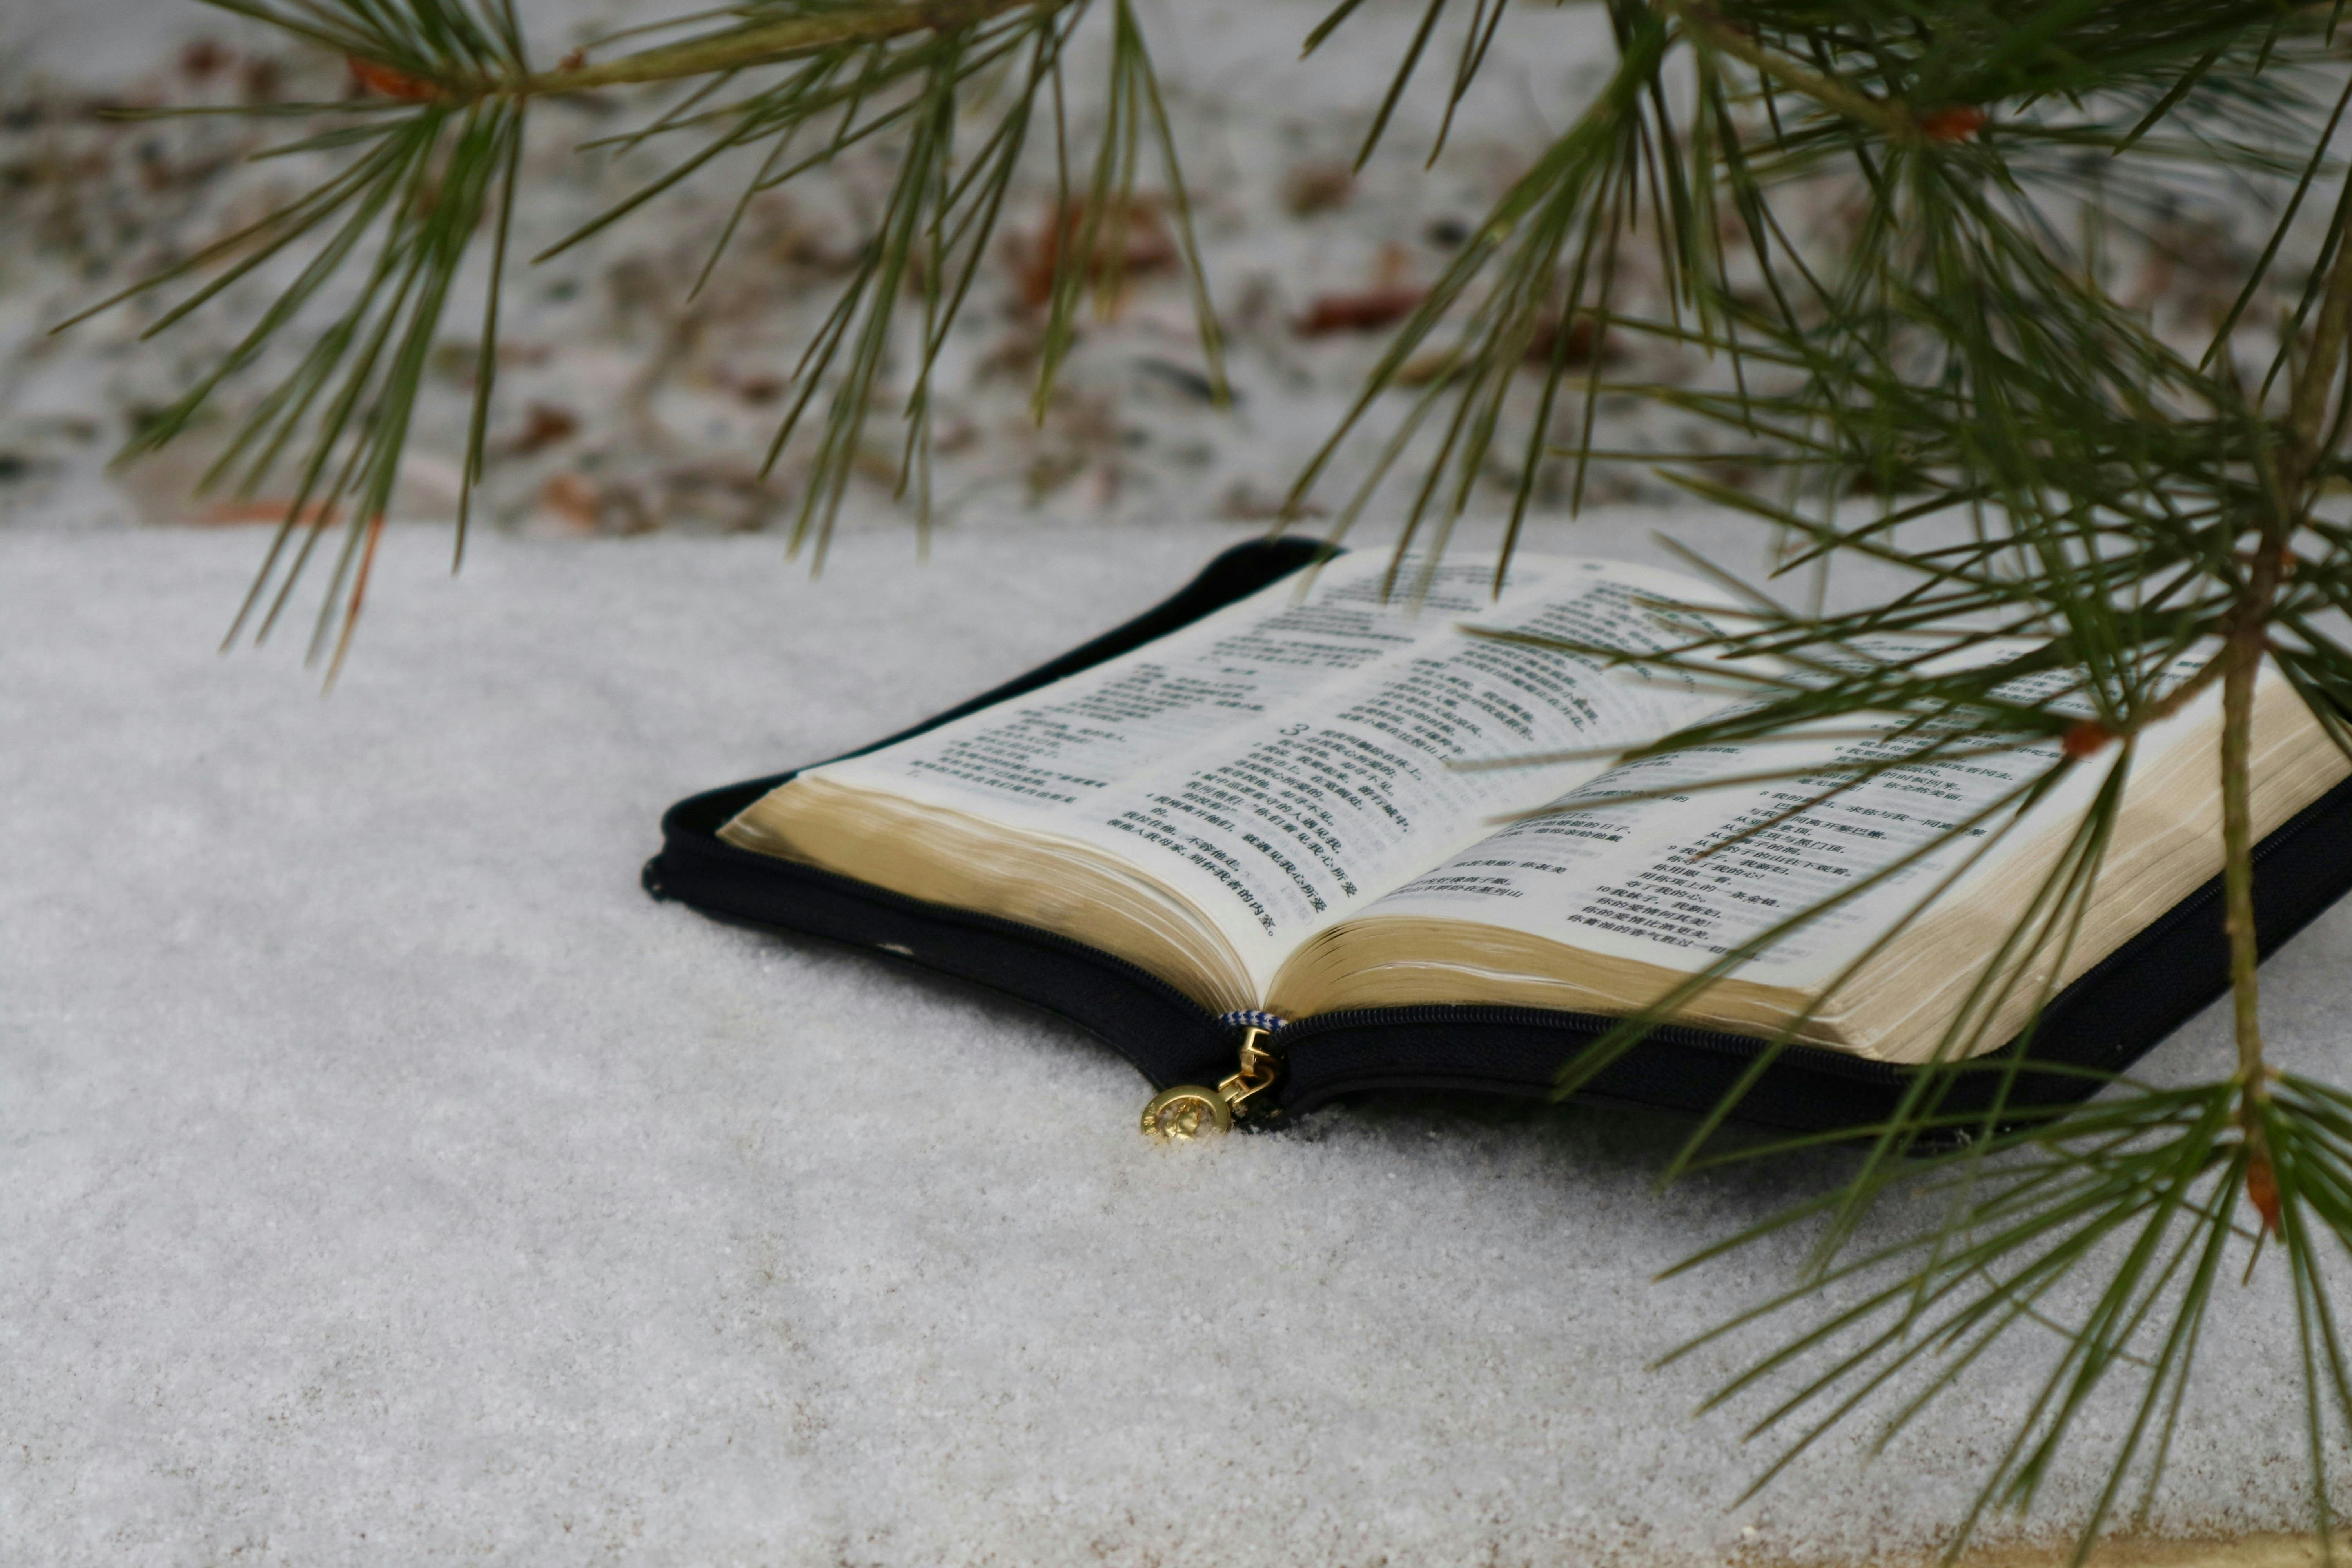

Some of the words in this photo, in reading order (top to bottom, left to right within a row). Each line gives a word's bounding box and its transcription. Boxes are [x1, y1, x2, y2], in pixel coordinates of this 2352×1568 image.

[1279, 723, 1310, 736] 3
[1751, 809, 1886, 840] 与我同离开黎巴嫩。
[1653, 864, 1731, 885] 你用眼一看,
[1680, 848, 1789, 875] 我子,我新妇,
[1626, 881, 1705, 903] 夺了我的心。
[1583, 906, 1708, 939] 你的爱情比酒更美,
[1597, 897, 1711, 927] 你的爱情何其美!
[1568, 915, 1760, 961] 你膏油的香气胜过一切。
